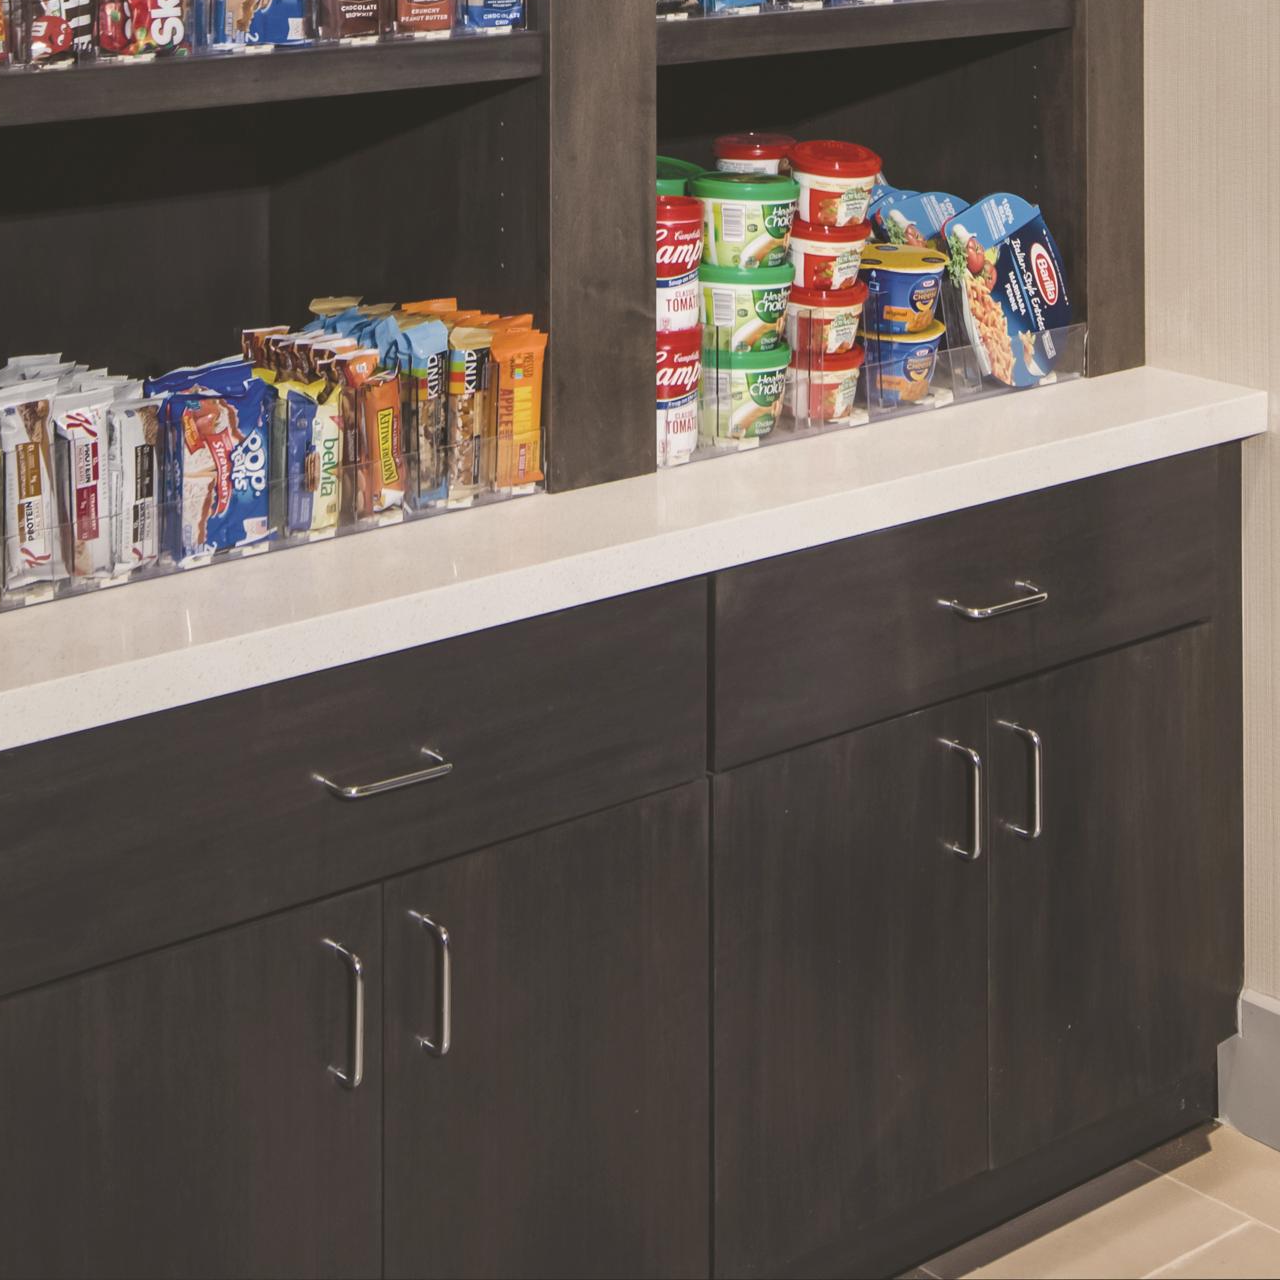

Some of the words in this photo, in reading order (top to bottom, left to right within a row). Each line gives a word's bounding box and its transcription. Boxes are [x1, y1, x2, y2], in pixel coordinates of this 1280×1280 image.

[341, 4, 377, 12] CHOCOLATE
[1004, 283, 1018, 312] PENNE
[1008, 271, 1027, 316] MARINARA
[1036, 258, 1055, 300] Barilla
[427, 353, 439, 400] KIND
[464, 350, 477, 395] KIND
[320, 438, 338, 497] belVita
